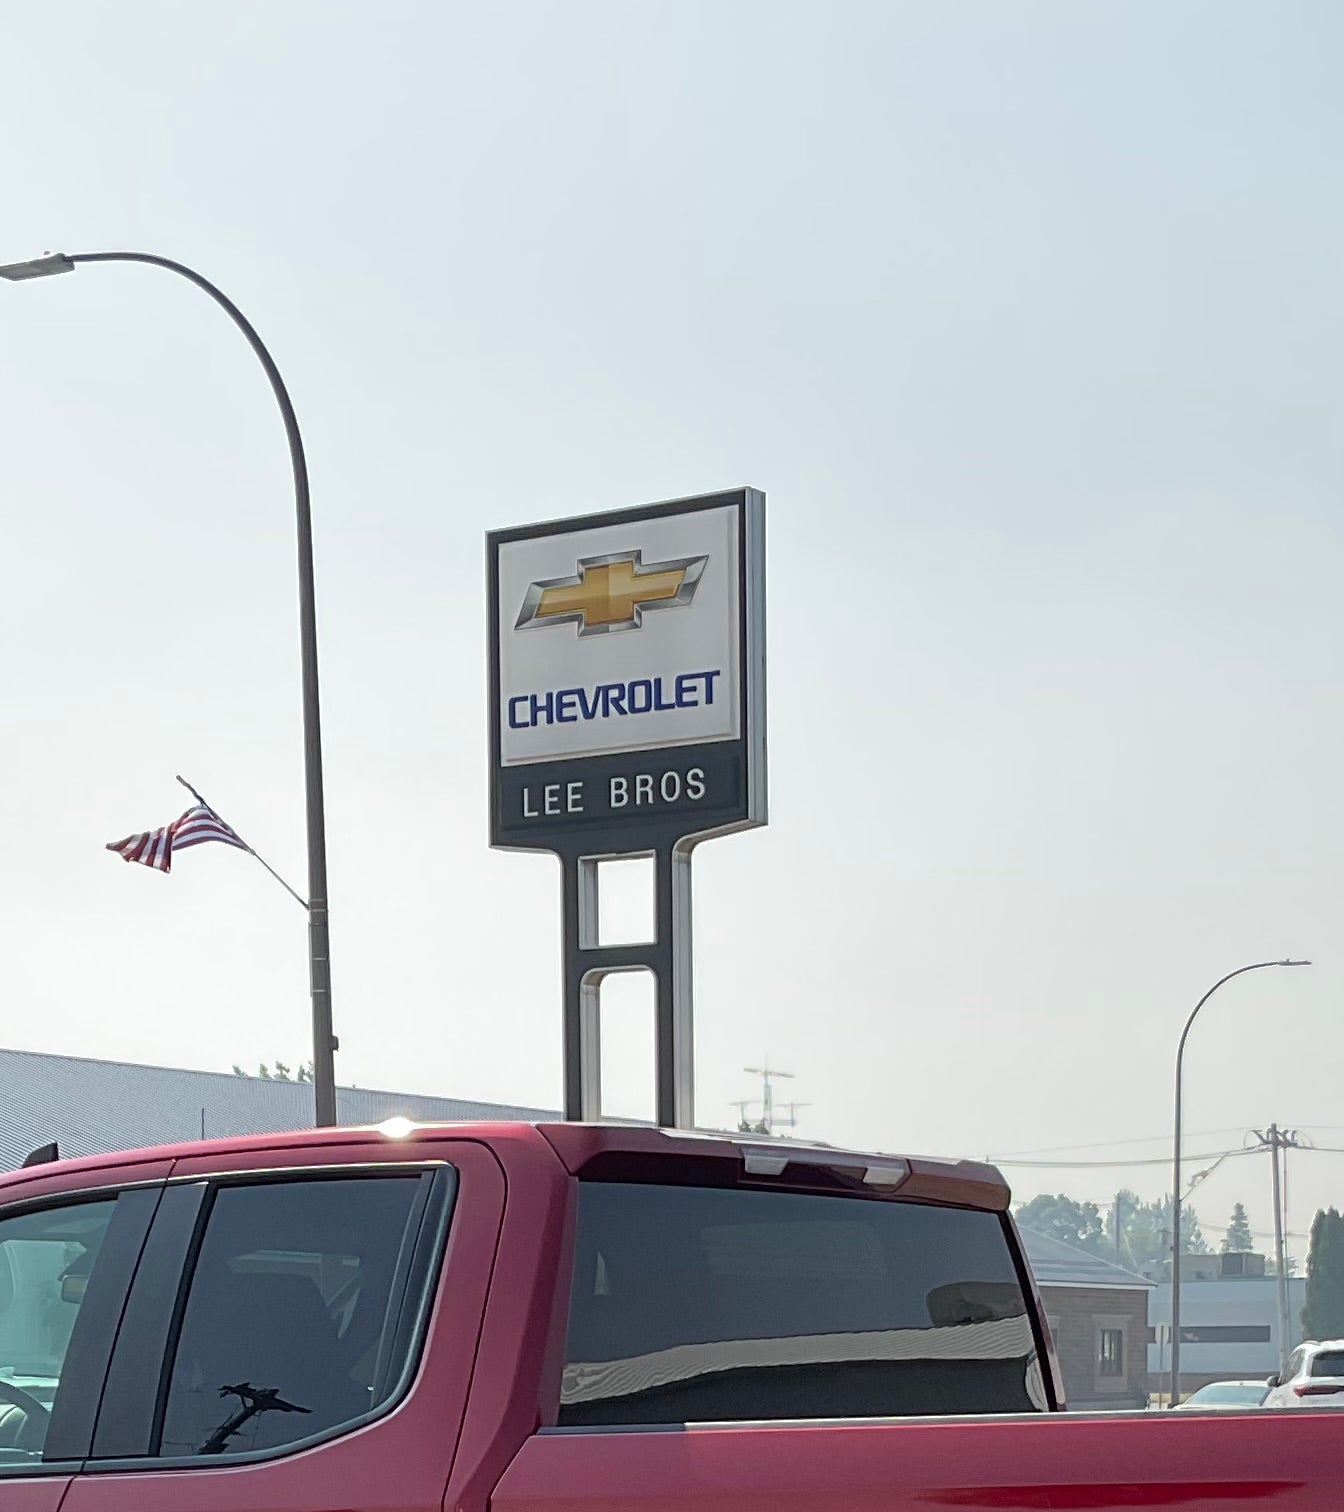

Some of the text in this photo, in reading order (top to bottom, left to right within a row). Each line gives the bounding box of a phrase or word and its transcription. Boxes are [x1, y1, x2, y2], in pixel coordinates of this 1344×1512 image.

[508, 669, 721, 730] CHEVROLET
[522, 768, 707, 818] LEE BROS
